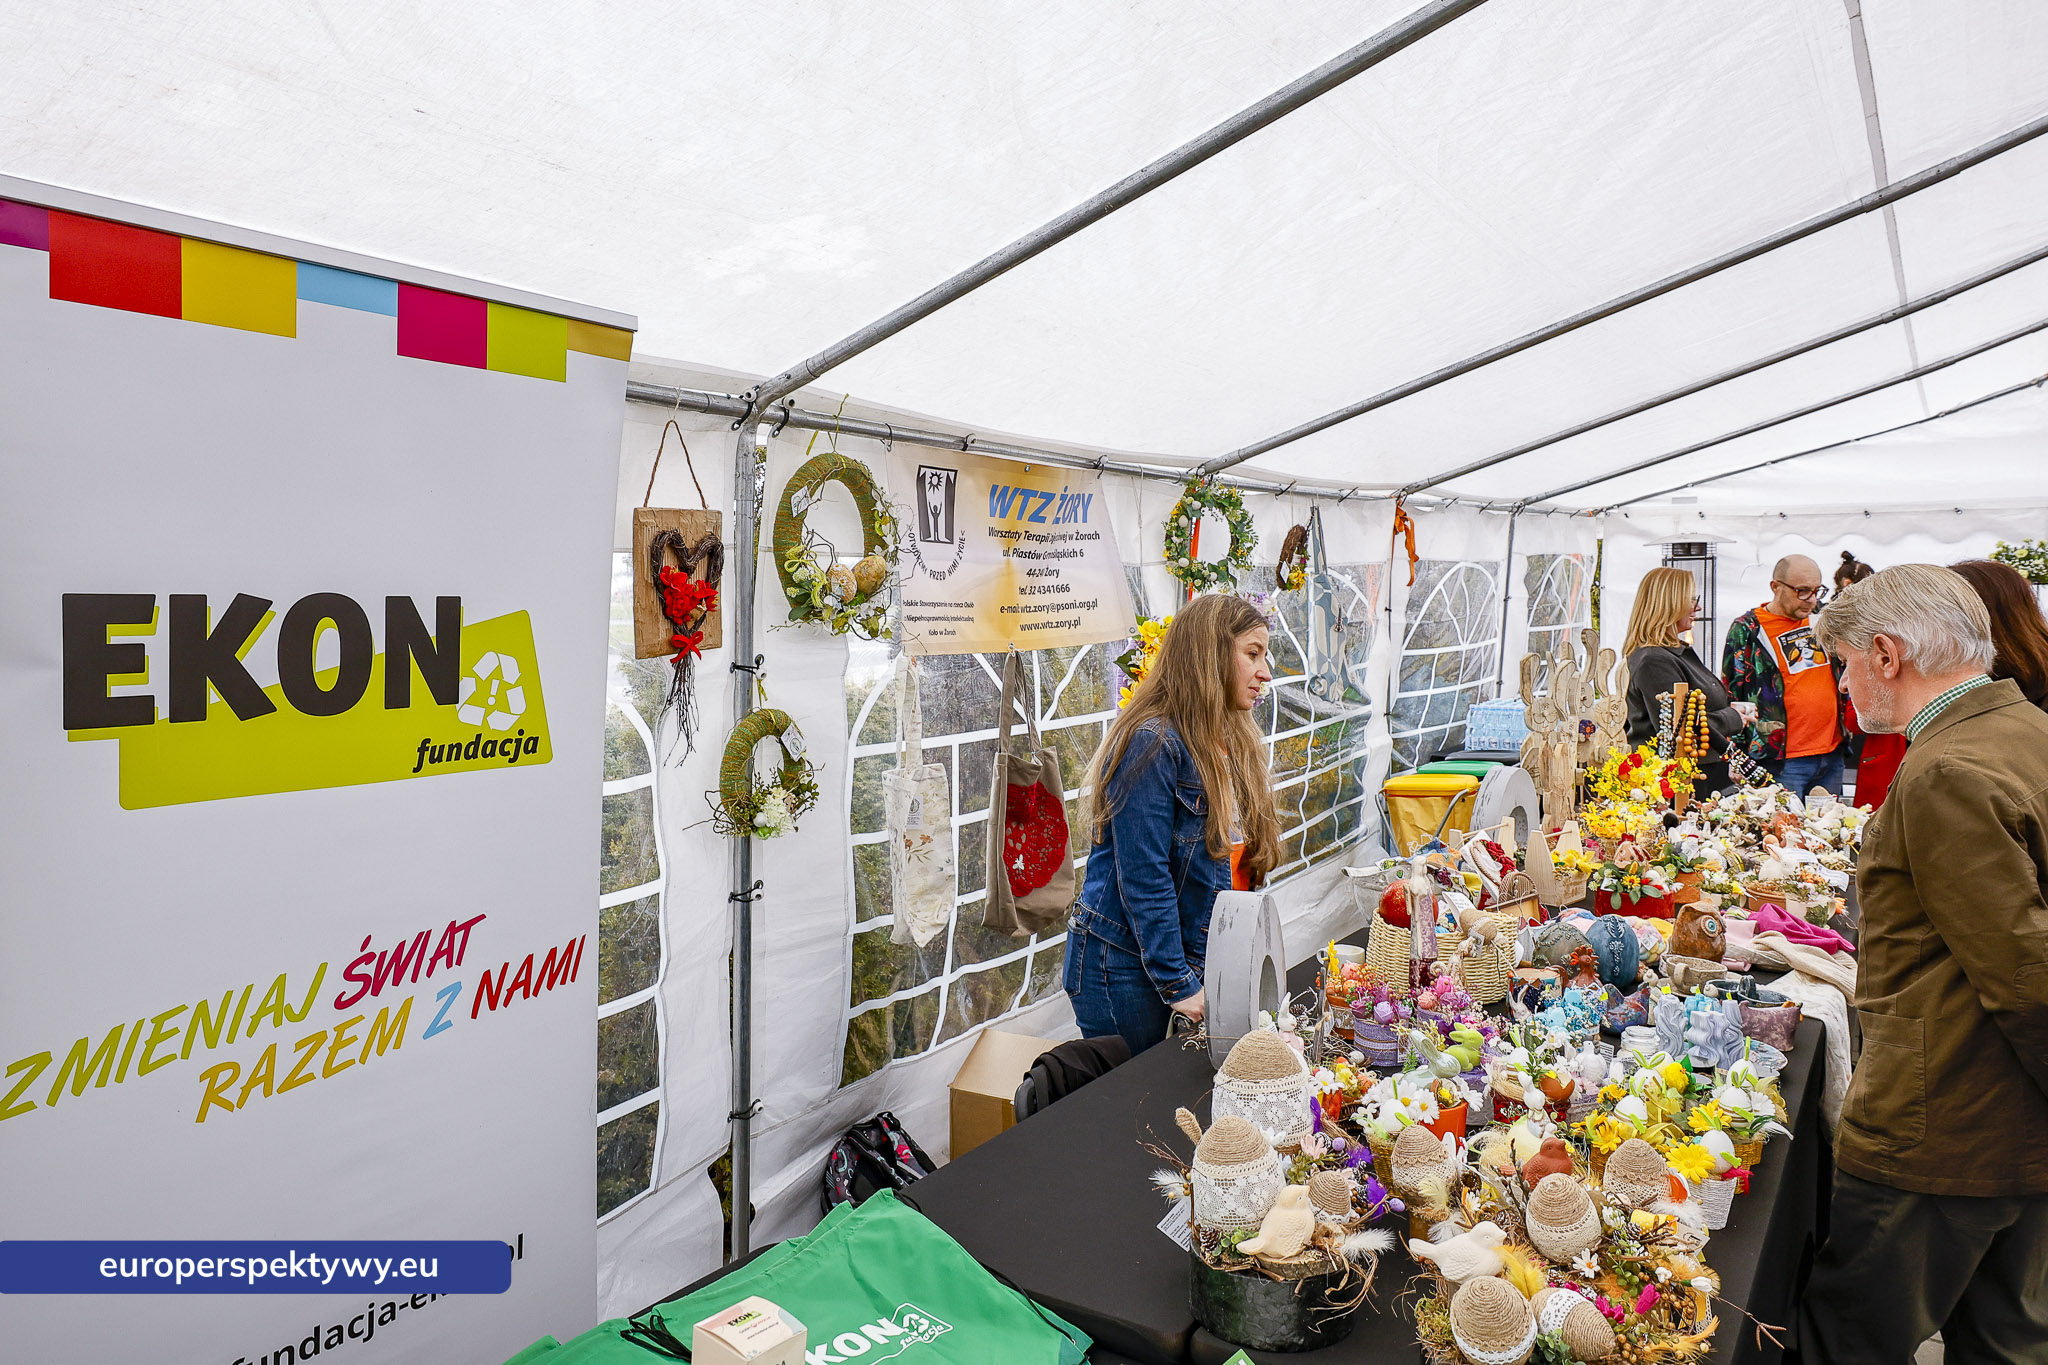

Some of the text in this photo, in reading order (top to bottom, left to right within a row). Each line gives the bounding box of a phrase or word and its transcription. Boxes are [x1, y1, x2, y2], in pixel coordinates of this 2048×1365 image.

[989, 484, 1093, 525] WTZ ŻORY
[988, 526, 1022, 542] Warsztaty
[1075, 529, 1100, 541] Żorach
[1002, 547, 1010, 557] ul.
[1012, 547, 1042, 560] Piastów
[1079, 548, 1085, 558] 6
[929, 569, 946, 581] PRZED
[947, 558, 960, 577] NIMI
[956, 537, 966, 560] ŻYCIE
[1044, 567, 1060, 579] Żory
[1028, 585, 1036, 595] 32
[1037, 583, 1071, 595] 4341666
[1020, 616, 1081, 631] www.wtz.zory.pl
[62, 593, 461, 731] EKON
[412, 732, 540, 773] fundacja
[0, 913, 487, 1121] ZMIENIAJ ŚWIAT
[195, 935, 587, 1123] RAZEM Z NAMI
